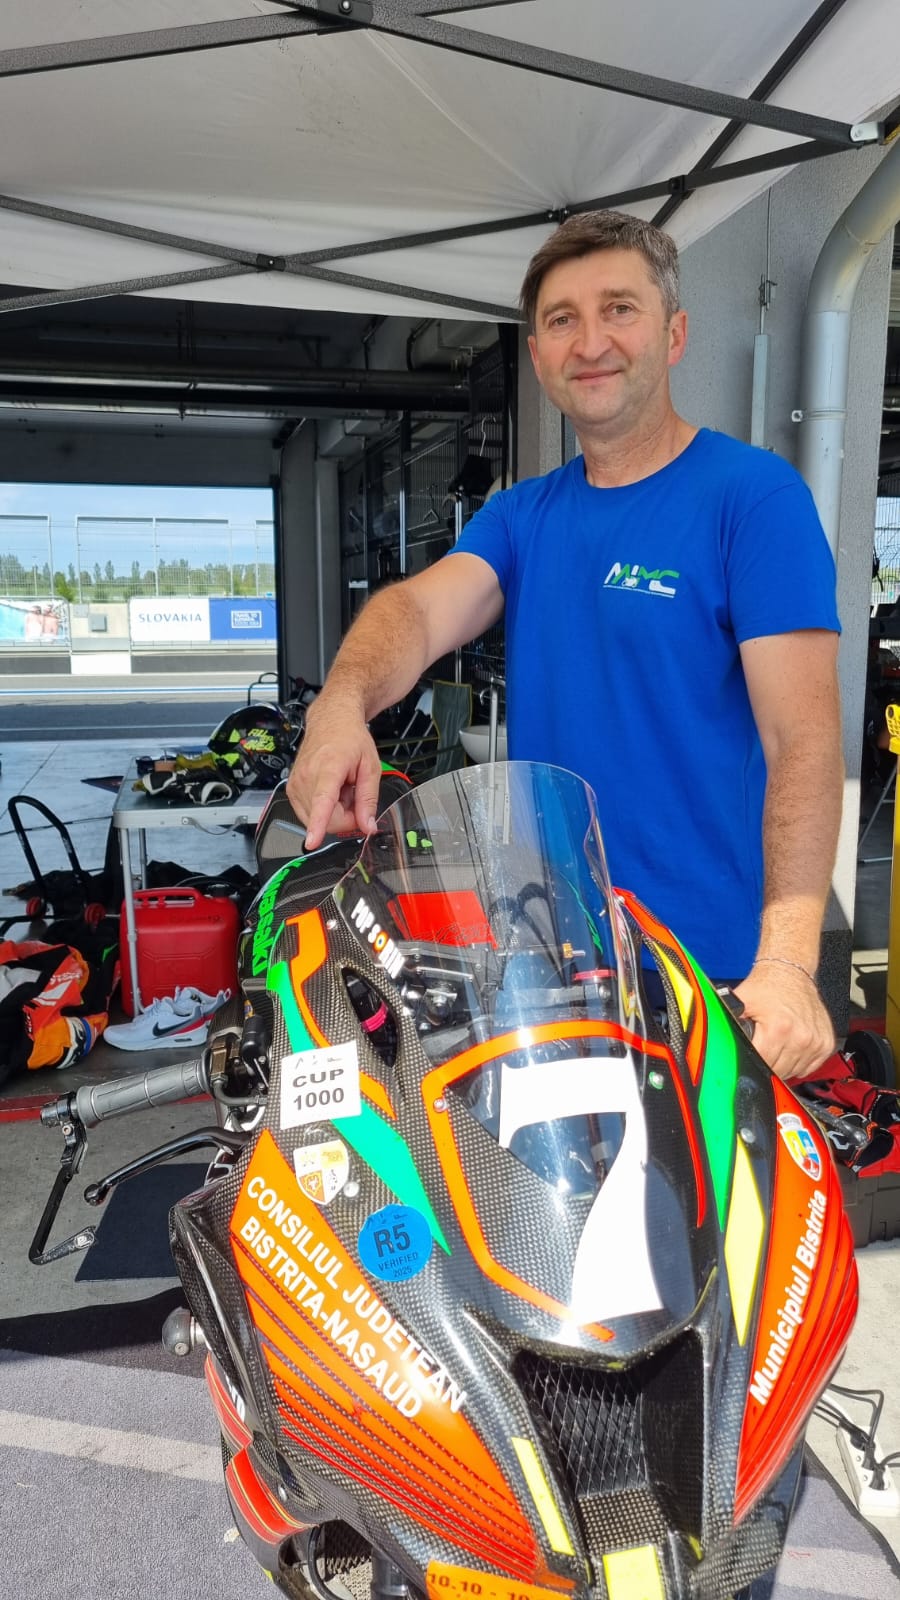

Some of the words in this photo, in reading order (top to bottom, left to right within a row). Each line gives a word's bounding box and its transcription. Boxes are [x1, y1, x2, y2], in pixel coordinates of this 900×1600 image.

[138, 612, 202, 623] SLOVAKIA
[292, 1068, 344, 1088] CUP
[293, 1087, 345, 1111] 1000
[498, 1055, 664, 1328] 7
[373, 1223, 411, 1258] R5
[378, 1251, 419, 1272] VERIFIED
[394, 1265, 412, 1278] 2025
[247, 1176, 344, 1289] CONSILIUL
[342, 1284, 467, 1413] JUDETEAN
[749, 1264, 809, 1405] Municipiul
[795, 1190, 827, 1269] Bistrita
[240, 1216, 422, 1418] BISTRITA-NASAUD
[428, 1573, 482, 1595] 10.10
